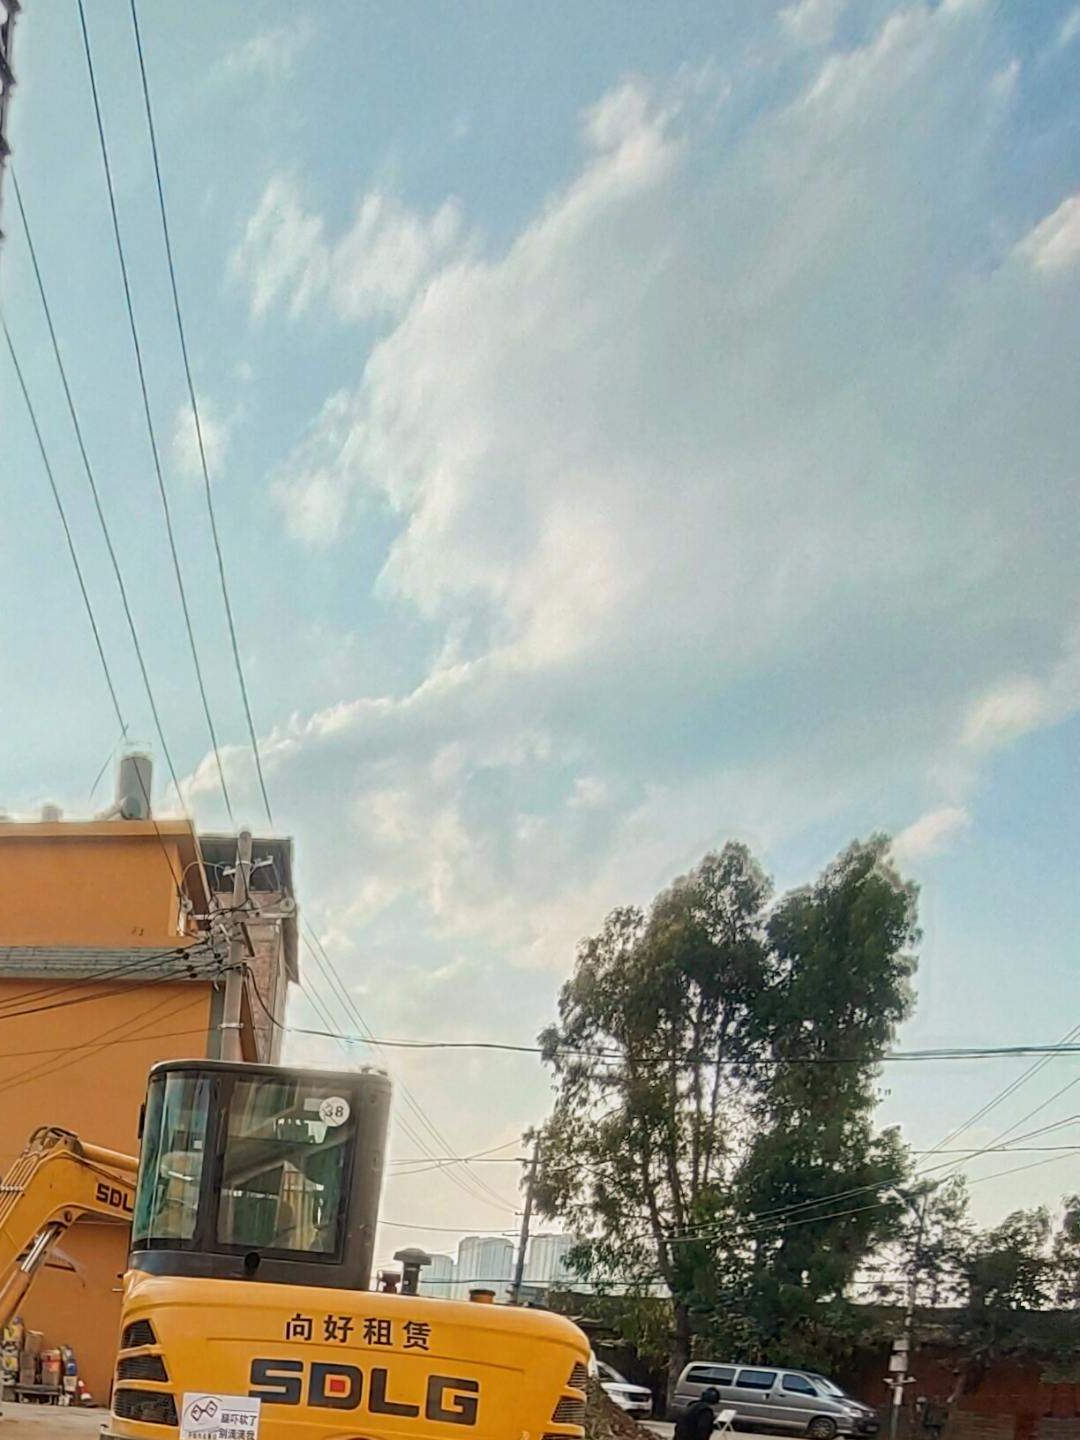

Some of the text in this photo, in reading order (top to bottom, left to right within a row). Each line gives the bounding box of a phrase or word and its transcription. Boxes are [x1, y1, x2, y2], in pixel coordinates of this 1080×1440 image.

[286, 1313, 431, 1350] 向好租赁
[248, 1358, 479, 1427] SDLG
